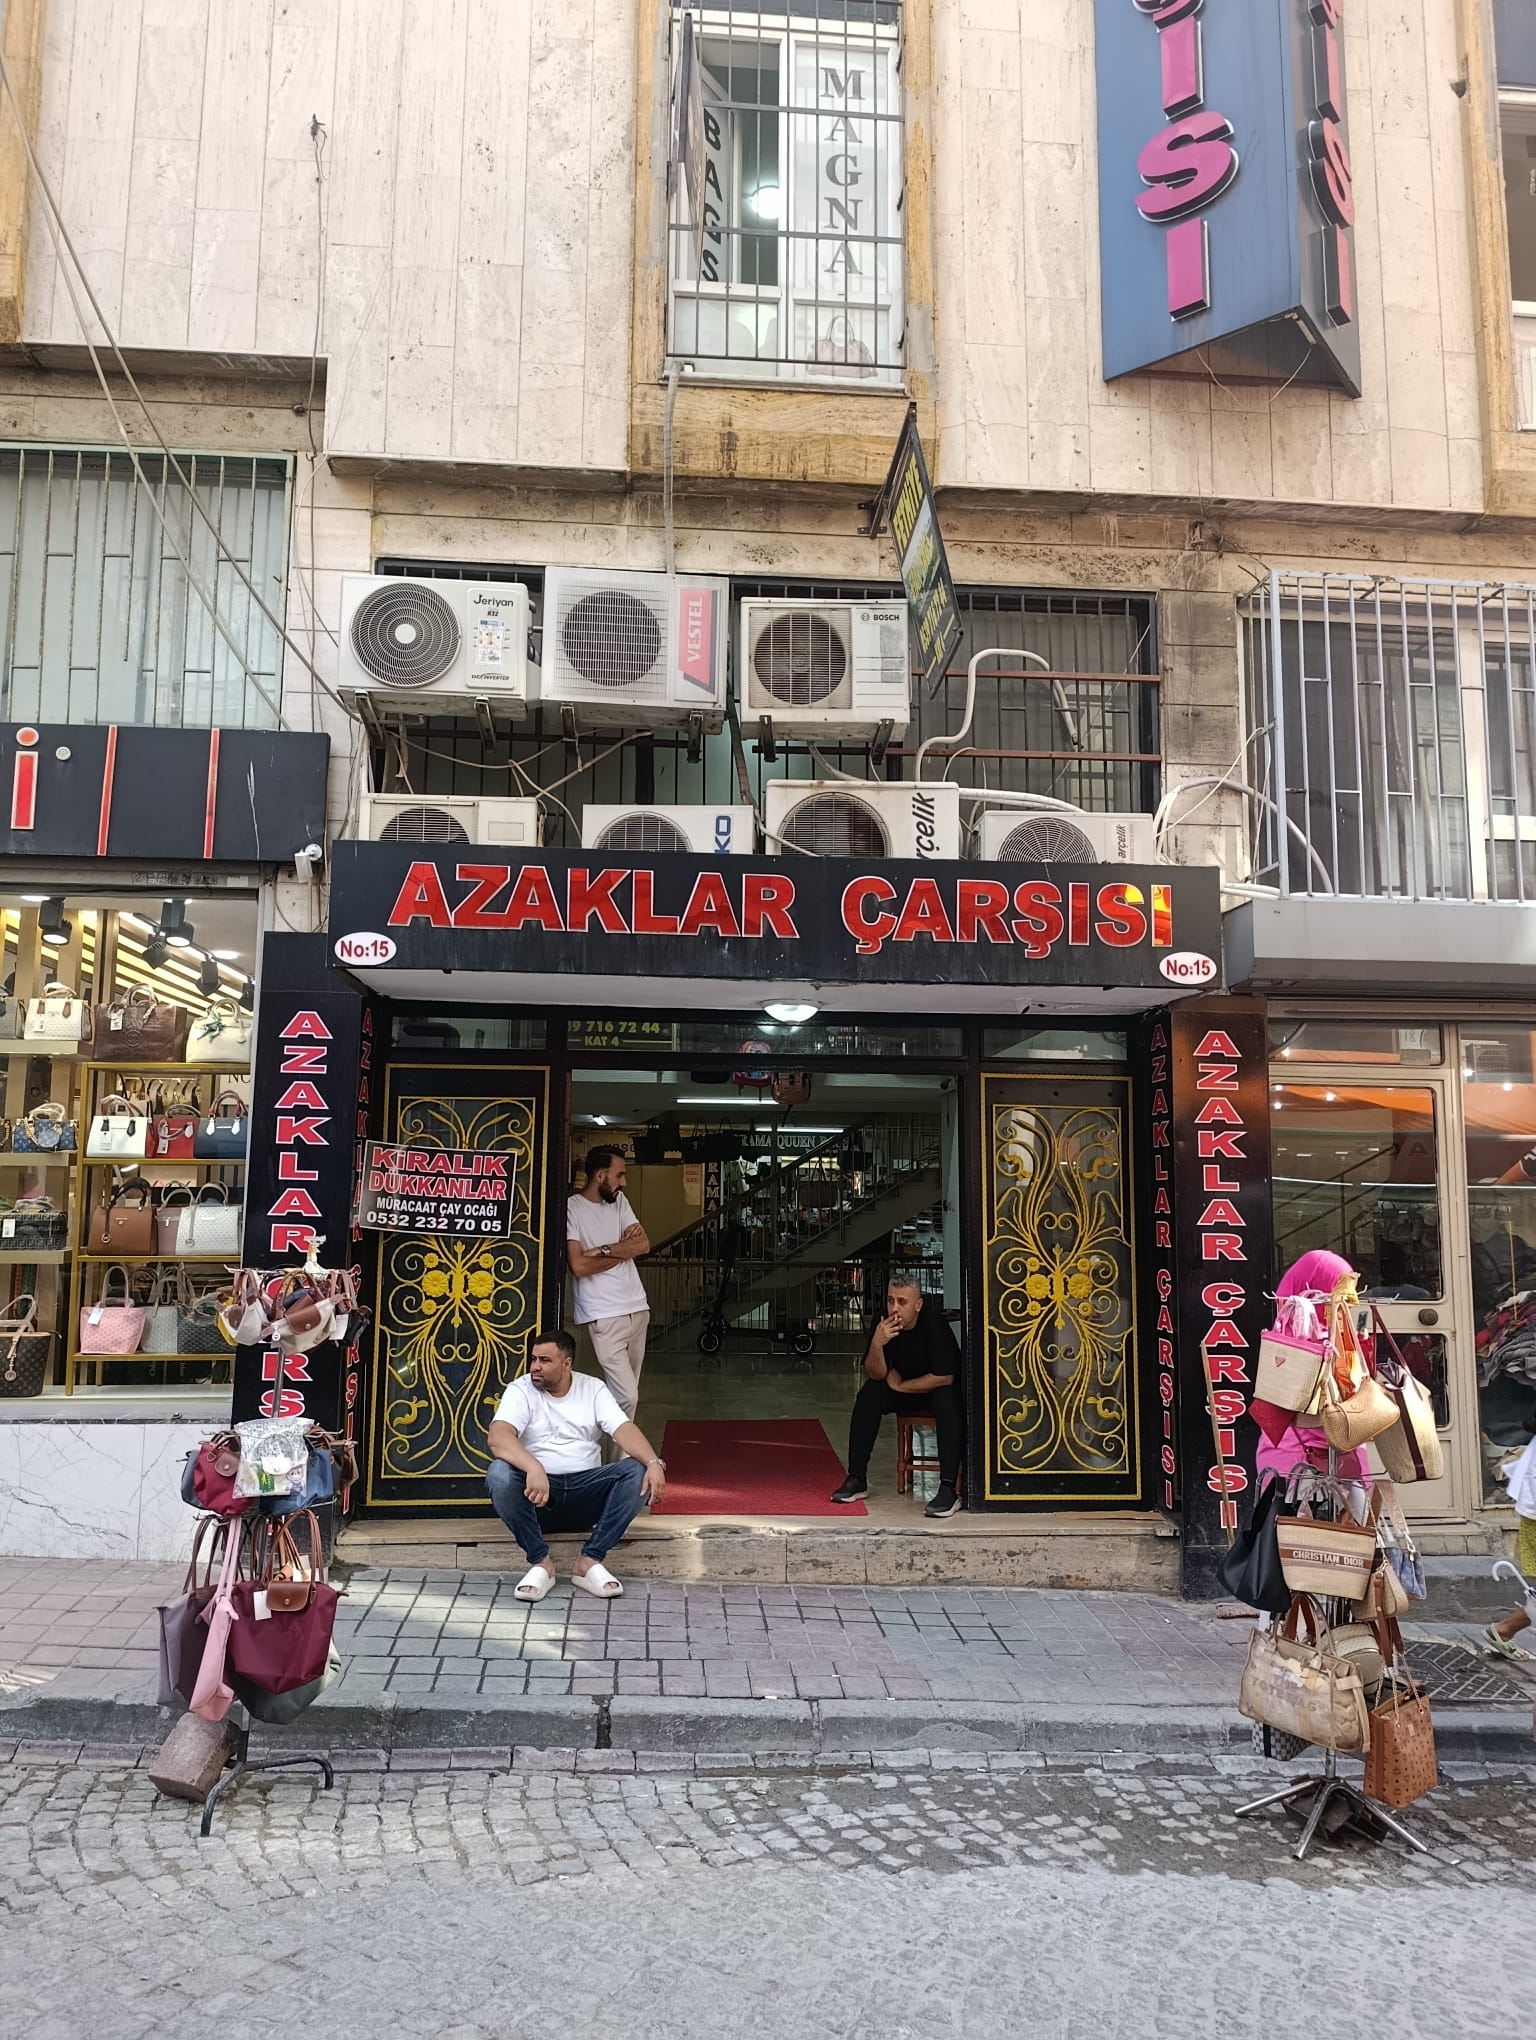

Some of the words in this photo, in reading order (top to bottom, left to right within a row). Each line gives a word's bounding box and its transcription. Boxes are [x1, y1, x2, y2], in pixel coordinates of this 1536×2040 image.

[820, 66, 865, 275] MAGNA
[703, 107, 723, 282] BAGS
[473, 593, 514, 608] Jeriyan
[687, 595, 703, 663] VESTEL
[715, 815, 731, 854] KO
[912, 792, 940, 859] rçelik
[1116, 824, 1128, 858] arçelik
[387, 862, 800, 938] AZAKLAR
[841, 876, 1172, 959] ÇARŞISI
[339, 939, 389, 958] No:15
[1165, 959, 1211, 977] No:15
[584, 1035, 608, 1047] KAT
[611, 1035, 620, 1047] 4
[586, 1020, 614, 1033] 716
[619, 1021, 637, 1033] 72
[641, 1022, 660, 1034] 44
[267, 1010, 334, 1254] AZAKLAR
[1151, 1023, 1172, 1249] AZAKLAR
[1193, 1030, 1249, 1262] AZAKLAR
[368, 1169, 507, 1200] DÜKKANLAR
[366, 1211, 410, 1227] 0532
[415, 1216, 448, 1230] 232
[454, 1218, 476, 1231] 70
[481, 1220, 502, 1232] 05
[376, 1196, 437, 1214] MÜRACAAT
[439, 1202, 462, 1217] ÇAY
[464, 1202, 498, 1217] OCAĞI
[1156, 1268, 1176, 1510] ÇARŞISI
[1201, 1282, 1251, 1529] ÇARŞISI
[1292, 1550, 1340, 1564] CHRISTIAN
[1343, 1556, 1364, 1568] DIOR
